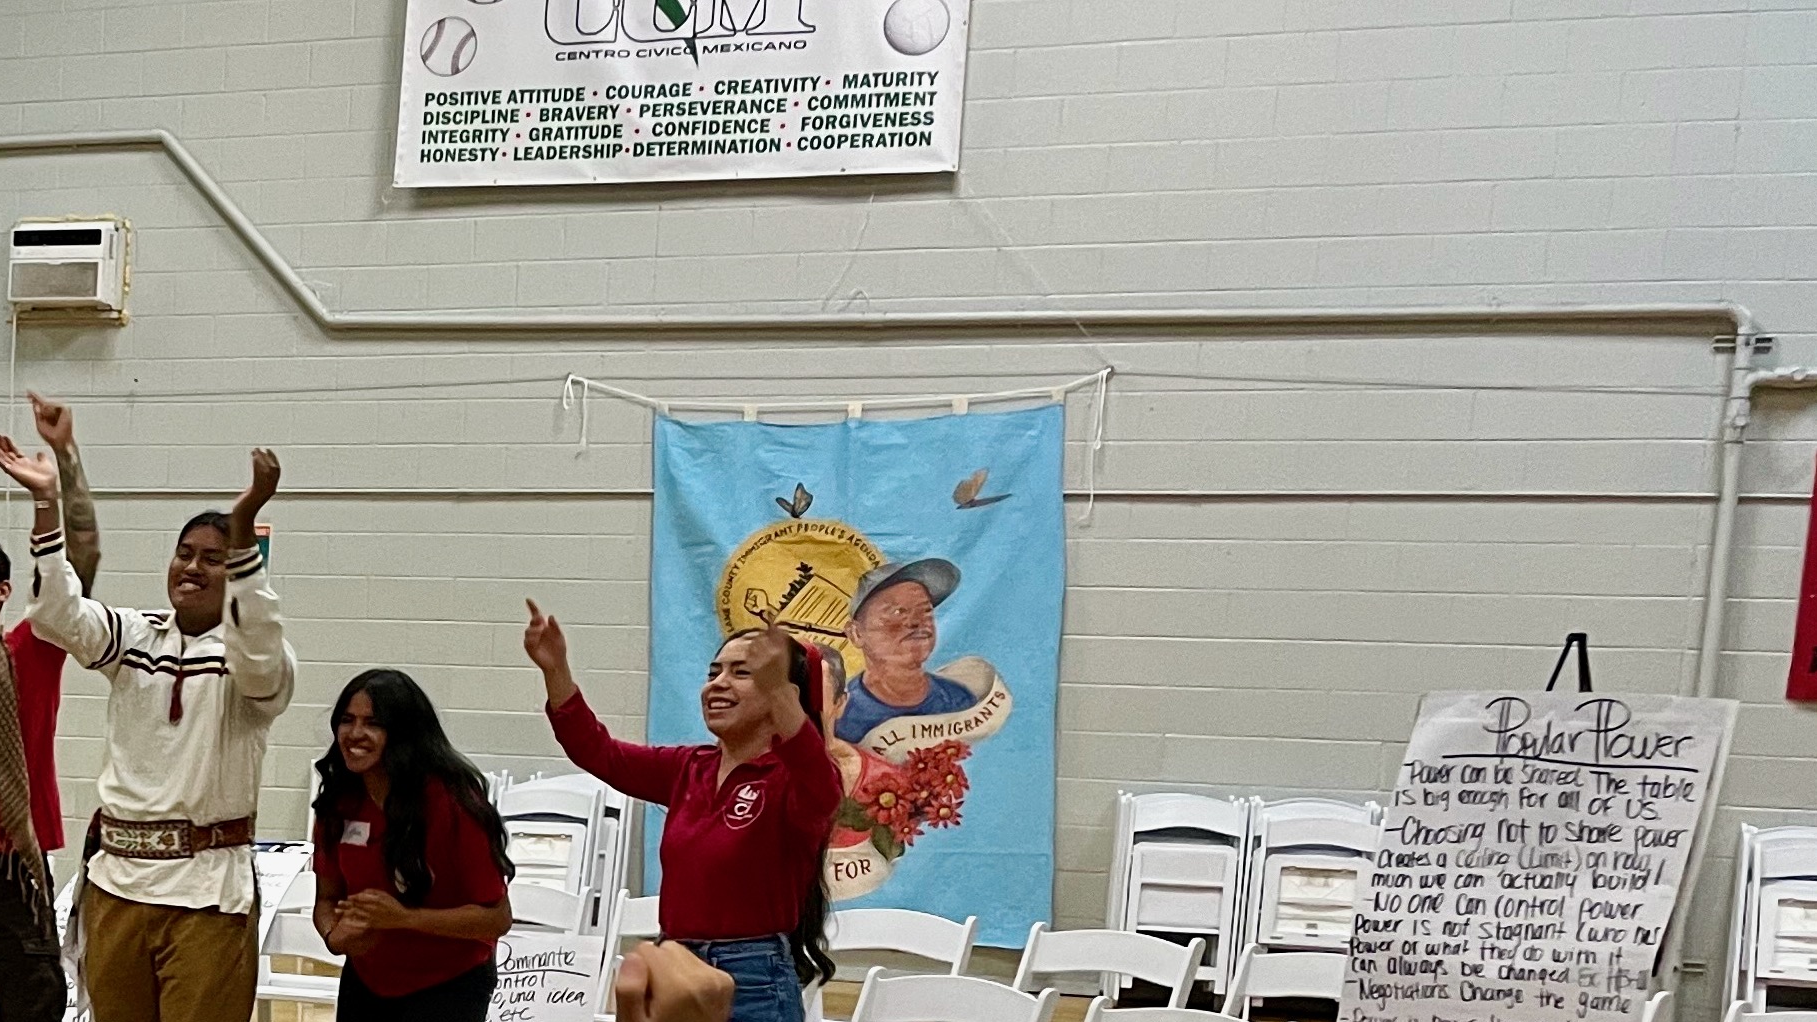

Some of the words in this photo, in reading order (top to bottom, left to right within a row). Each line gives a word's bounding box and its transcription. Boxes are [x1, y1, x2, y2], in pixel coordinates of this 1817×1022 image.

[555, 49, 631, 62] CENTRO
[636, 46, 697, 59] CIVICO
[702, 40, 808, 55] MEXICANO
[424, 91, 502, 107] POSITIVE
[506, 87, 586, 105] ATTITUDE
[605, 82, 693, 100] COURAGE
[714, 75, 822, 95] CREATIVITY
[842, 71, 940, 89] MATURITY
[423, 109, 521, 126] DISCIPLINE
[539, 104, 620, 122] BRAVERY
[639, 98, 788, 118] PERSEVERANCE
[807, 91, 938, 111] COMMITMENT
[421, 128, 511, 144] INTEGRITY
[528, 124, 624, 142] GRATITUDE
[651, 118, 771, 137] CONFIDENCE
[800, 111, 935, 132] FORGIVENESS
[420, 147, 501, 163] HONESTY
[513, 144, 623, 161] LEADERSHIP
[632, 138, 782, 158] DETERMINATION
[796, 131, 933, 151] COOPERATION
[721, 564, 741, 606] COUNTY
[736, 525, 794, 566] IMMIGRANT
[796, 522, 846, 540] PEOPLE'S
[846, 533, 882, 570] AGENDA
[871, 729, 906, 756] ALL
[911, 690, 1006, 740] IMMIGRANTS
[1573, 698, 1695, 764] Power
[1460, 764, 1487, 785] can
[1493, 764, 1514, 785] be
[1588, 770, 1631, 796] The
[1636, 774, 1696, 803] table
[1422, 787, 1451, 812] big
[1518, 786, 1550, 810] for
[1587, 795, 1617, 817] of
[1538, 821, 1558, 846] to
[833, 857, 872, 882] FOR
[1436, 851, 1447, 869] a
[1585, 851, 1607, 869] on
[1419, 873, 1447, 890] we
[1453, 873, 1485, 890] can
[1441, 917, 1471, 938] not
[1401, 940, 1419, 956] or
[1424, 939, 1470, 956] what
[1522, 945, 1545, 963] do
[496, 970, 547, 990] ontrol
[1351, 956, 1378, 974] can
[1387, 955, 1449, 983] always
[1460, 960, 1487, 979] be
[1497, 963, 1570, 986] changed
[508, 990, 536, 1005] una
[546, 987, 588, 1007] idea
[1533, 987, 1565, 1010] the
[1575, 990, 1633, 1019] game
[498, 1006, 536, 1022] etc
